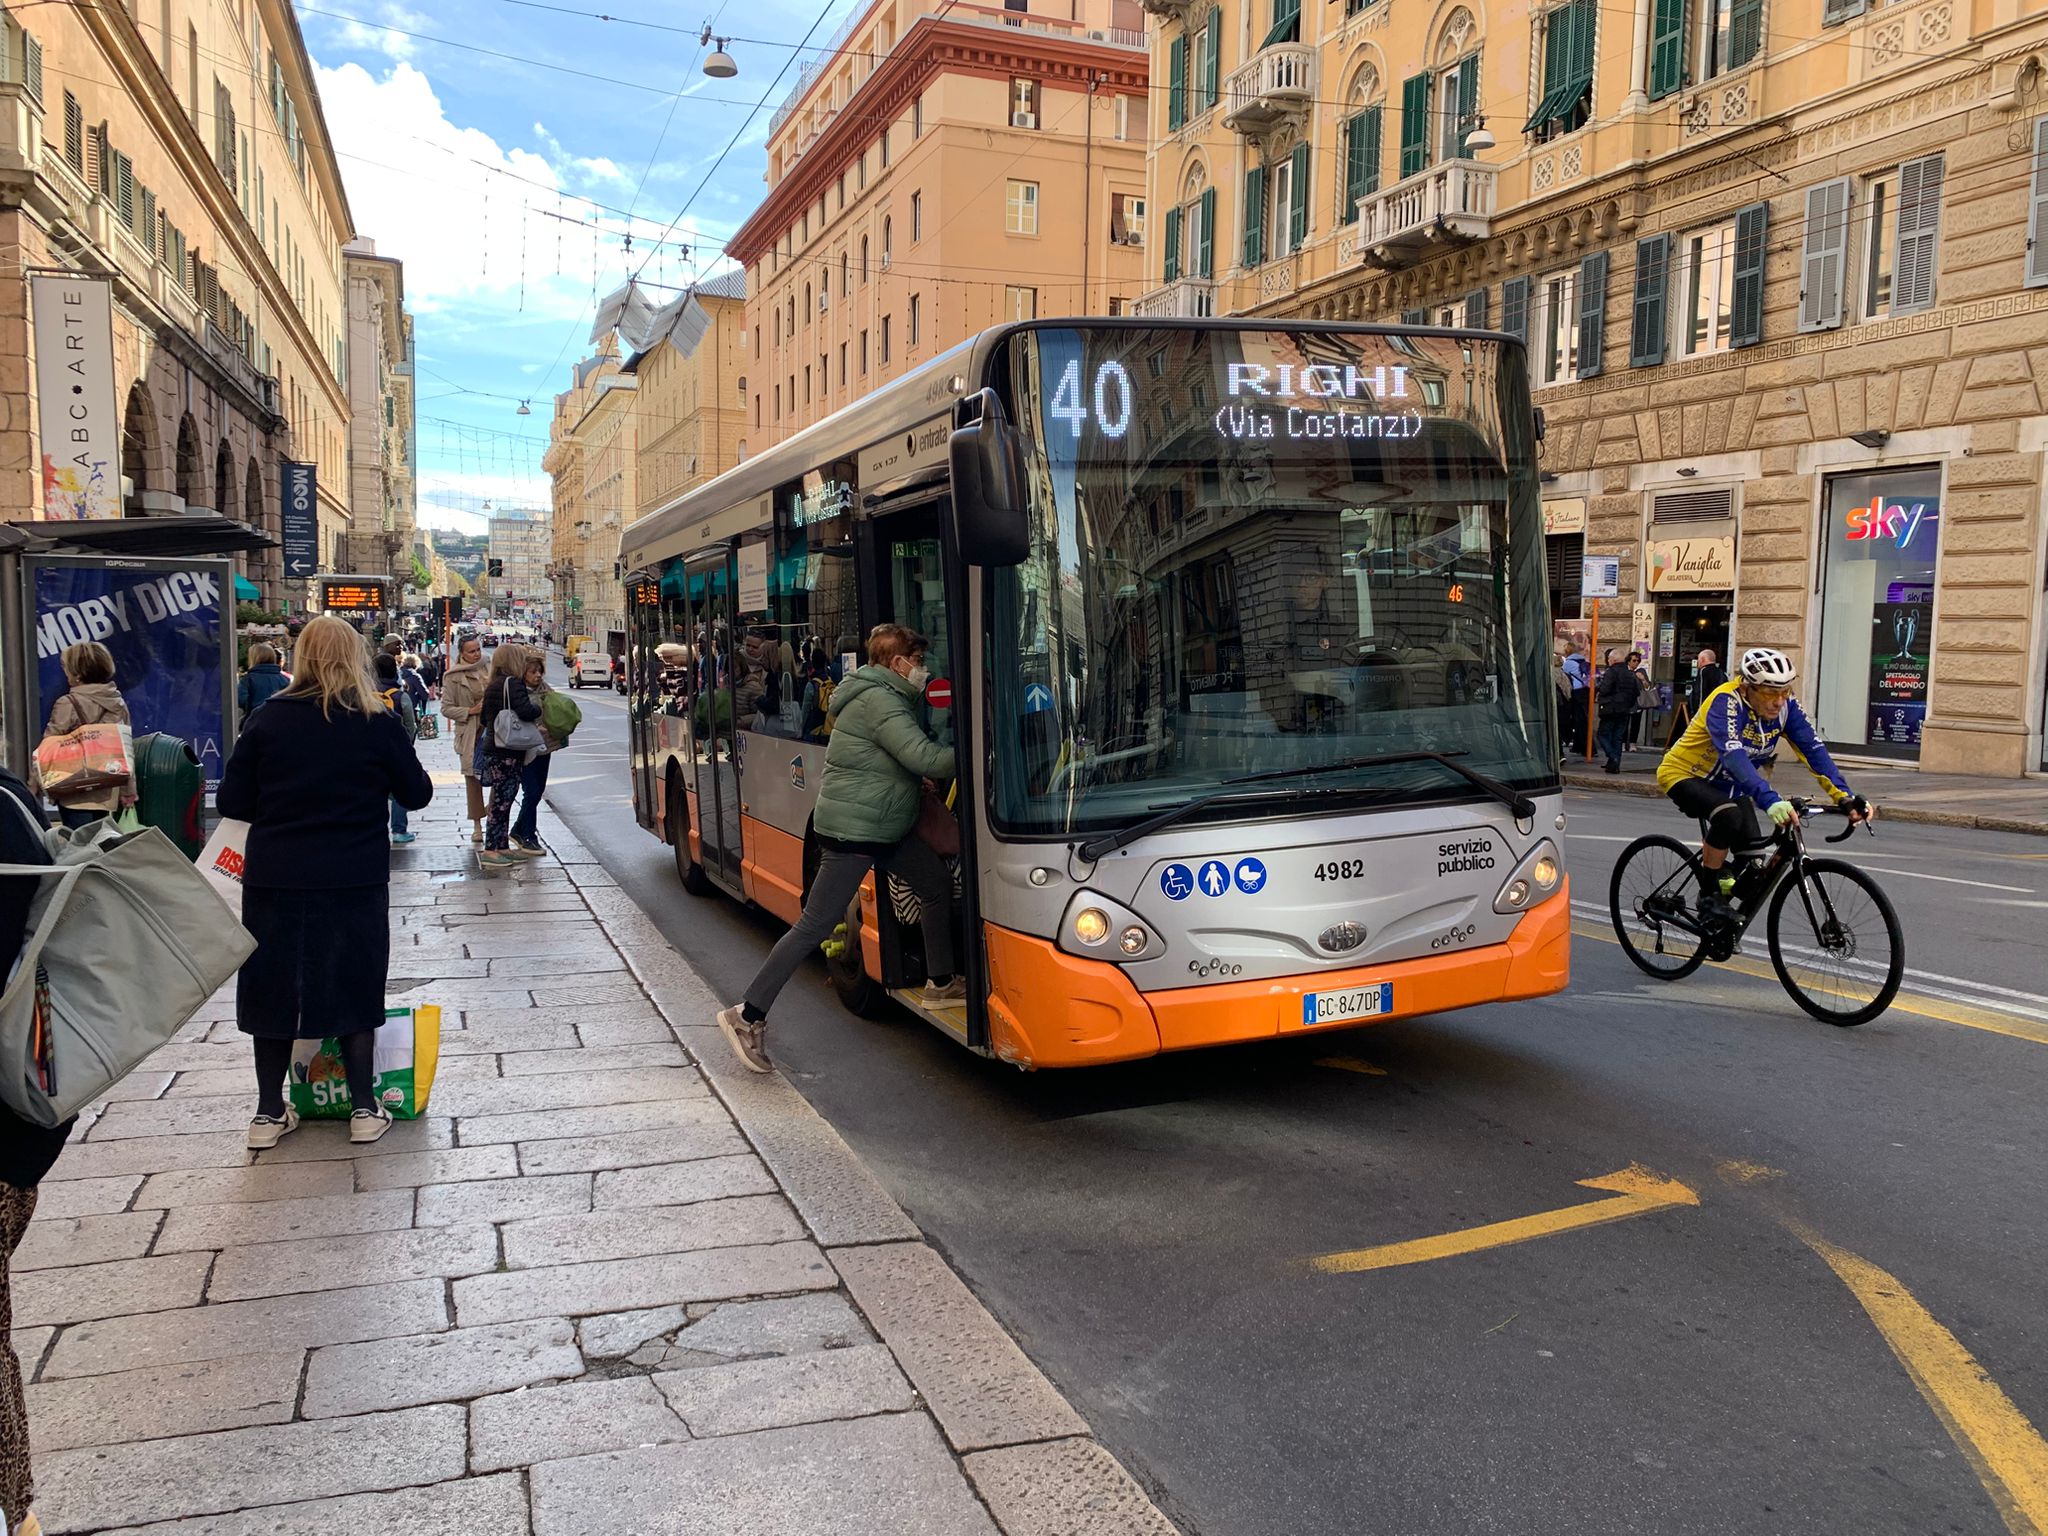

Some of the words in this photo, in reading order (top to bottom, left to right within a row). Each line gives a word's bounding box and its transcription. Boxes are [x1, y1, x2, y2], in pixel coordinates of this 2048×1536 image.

[1228, 363, 1409, 398] RIGHI
[1051, 359, 1131, 438] 40
[1215, 407, 1275, 438] (Via
[1287, 407, 1423, 438] Costanzi)
[919, 424, 948, 452] entrata
[293, 469, 309, 511] MOG
[1845, 495, 1925, 549] sky
[105, 560, 146, 568] IGPDecaux
[1672, 541, 1722, 584] Vaniglia
[1448, 584, 1464, 602] 46
[1907, 593, 1920, 604] sky
[37, 590, 132, 659] MOBY
[133, 571, 220, 624] DICK
[1879, 680, 1893, 689] DEL
[1893, 681, 1926, 690] MONDO
[1885, 672, 1921, 680] SPETTACOLO
[1438, 837, 1492, 857] servizio
[211, 865, 231, 878] SENZA
[1314, 859, 1364, 882] 4982
[1437, 854, 1496, 877] pubblico
[1317, 996, 1335, 1017] GC
[1339, 990, 1381, 1014] 847DP
